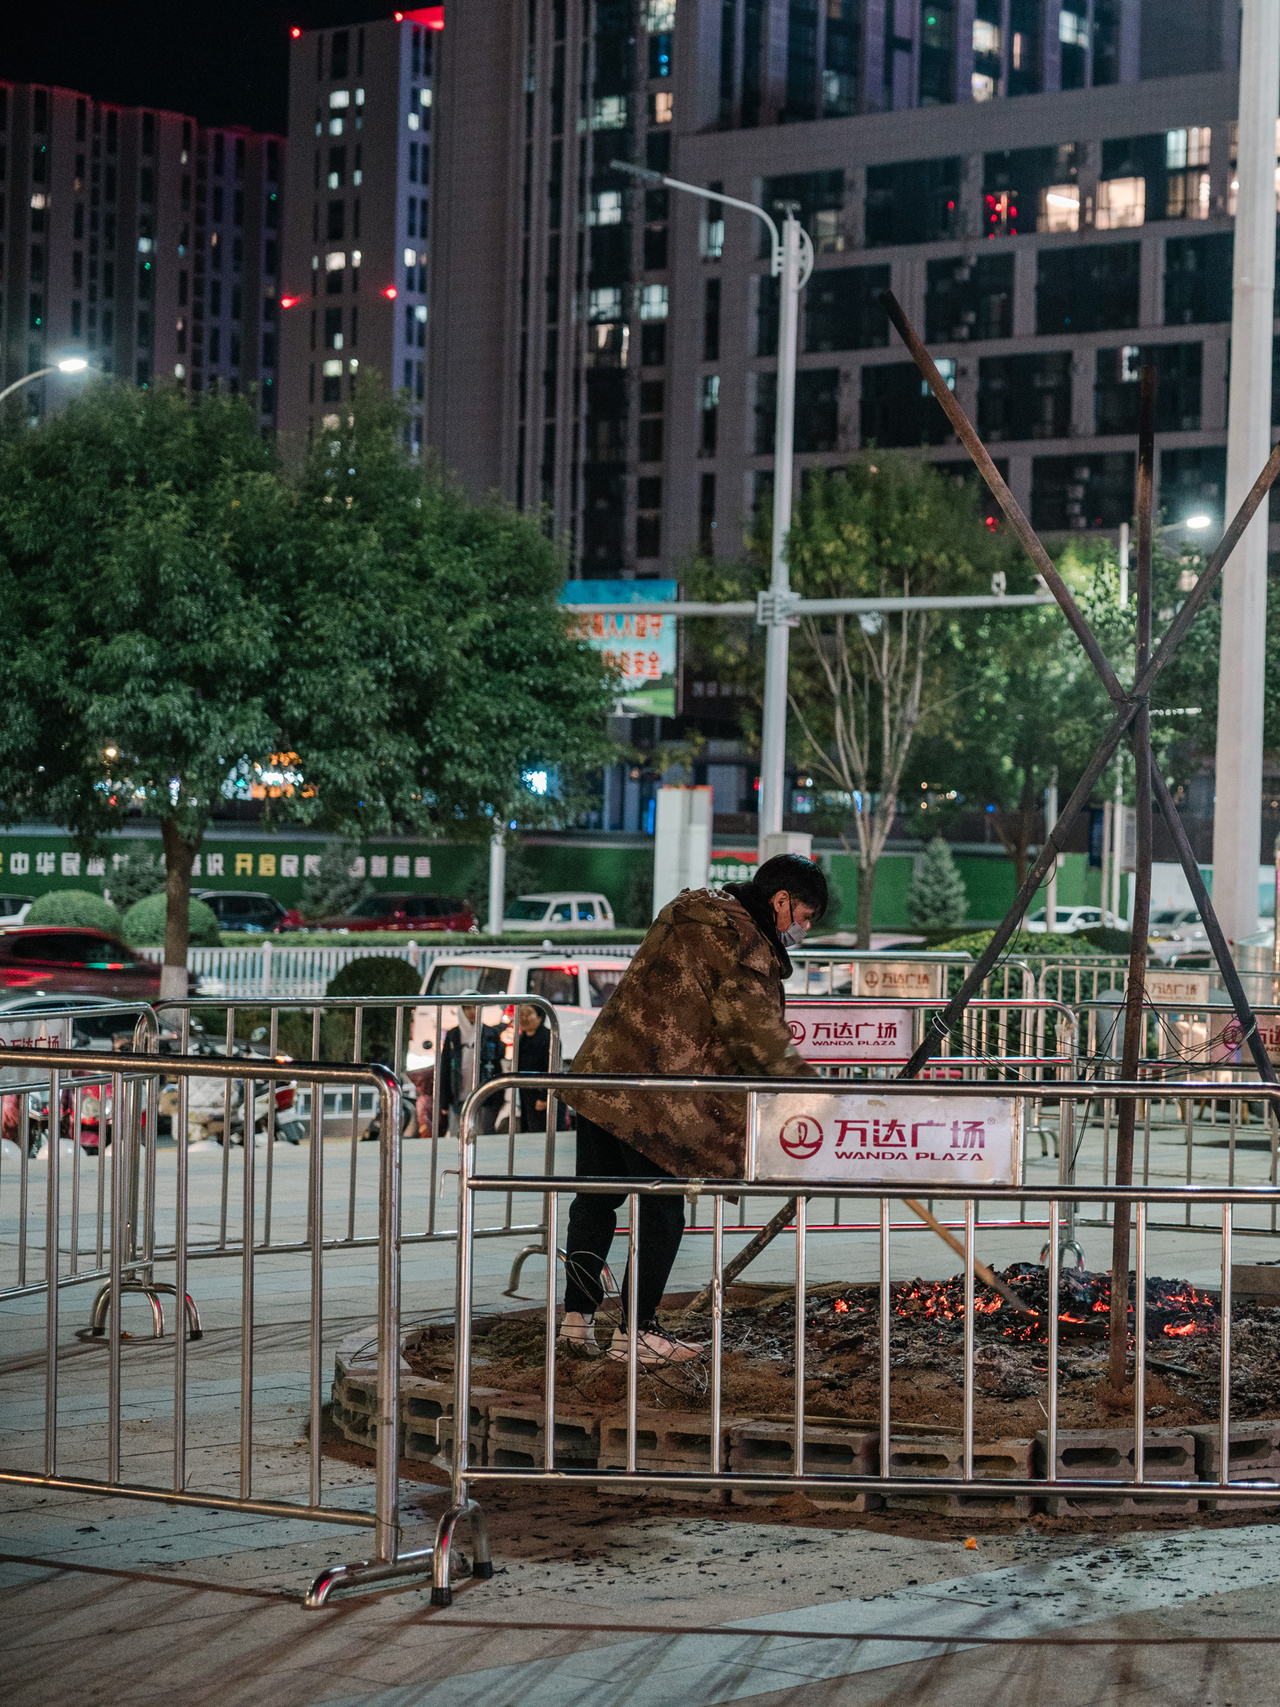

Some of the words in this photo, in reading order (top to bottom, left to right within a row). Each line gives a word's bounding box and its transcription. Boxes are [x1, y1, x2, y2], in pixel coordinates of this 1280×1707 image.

[812, 1022, 897, 1039] 万达广场
[834, 1119, 986, 1149] 万达广场
[835, 1151, 909, 1161] WANDA
[915, 1151, 984, 1162] PLAZA
